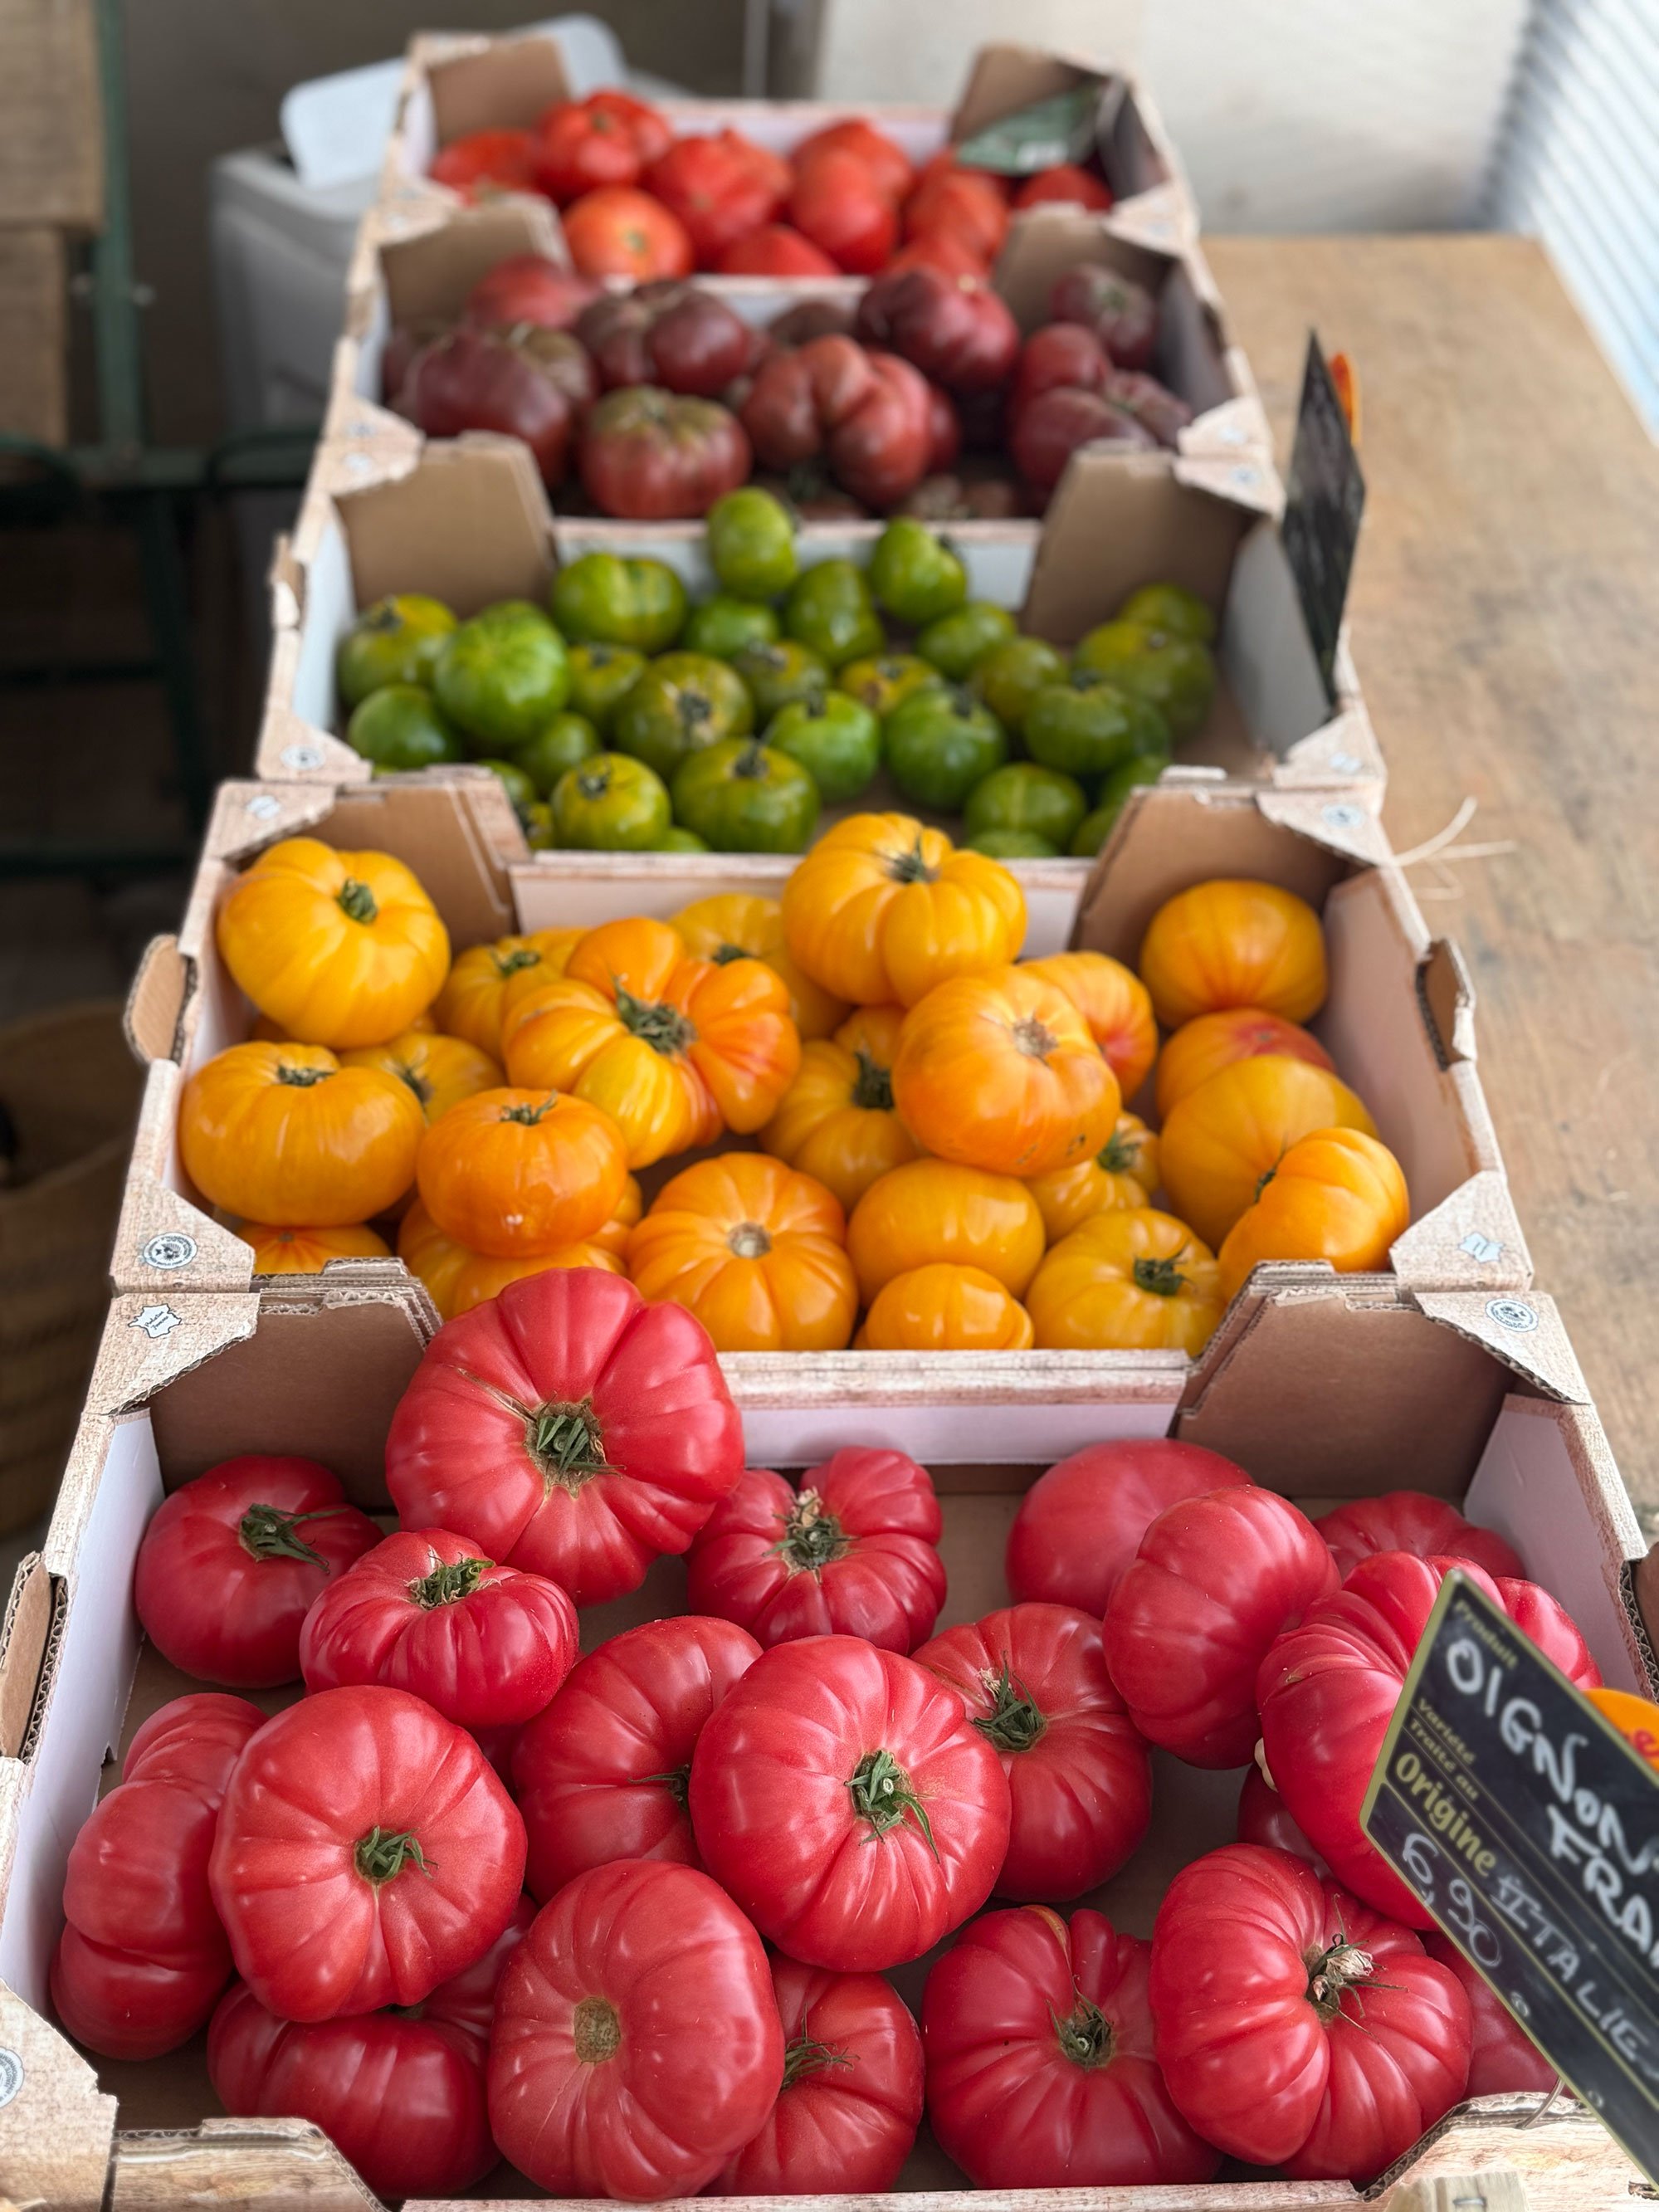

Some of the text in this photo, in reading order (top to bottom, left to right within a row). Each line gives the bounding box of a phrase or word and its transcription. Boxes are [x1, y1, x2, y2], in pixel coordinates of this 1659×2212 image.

[1454, 1600, 1520, 1670] Produit
[1408, 1716, 1480, 1801] Traité au
[1417, 1697, 1476, 1766] Variété
[1395, 1751, 1497, 1876] Origine
[1546, 1803, 1659, 1970] FRA
